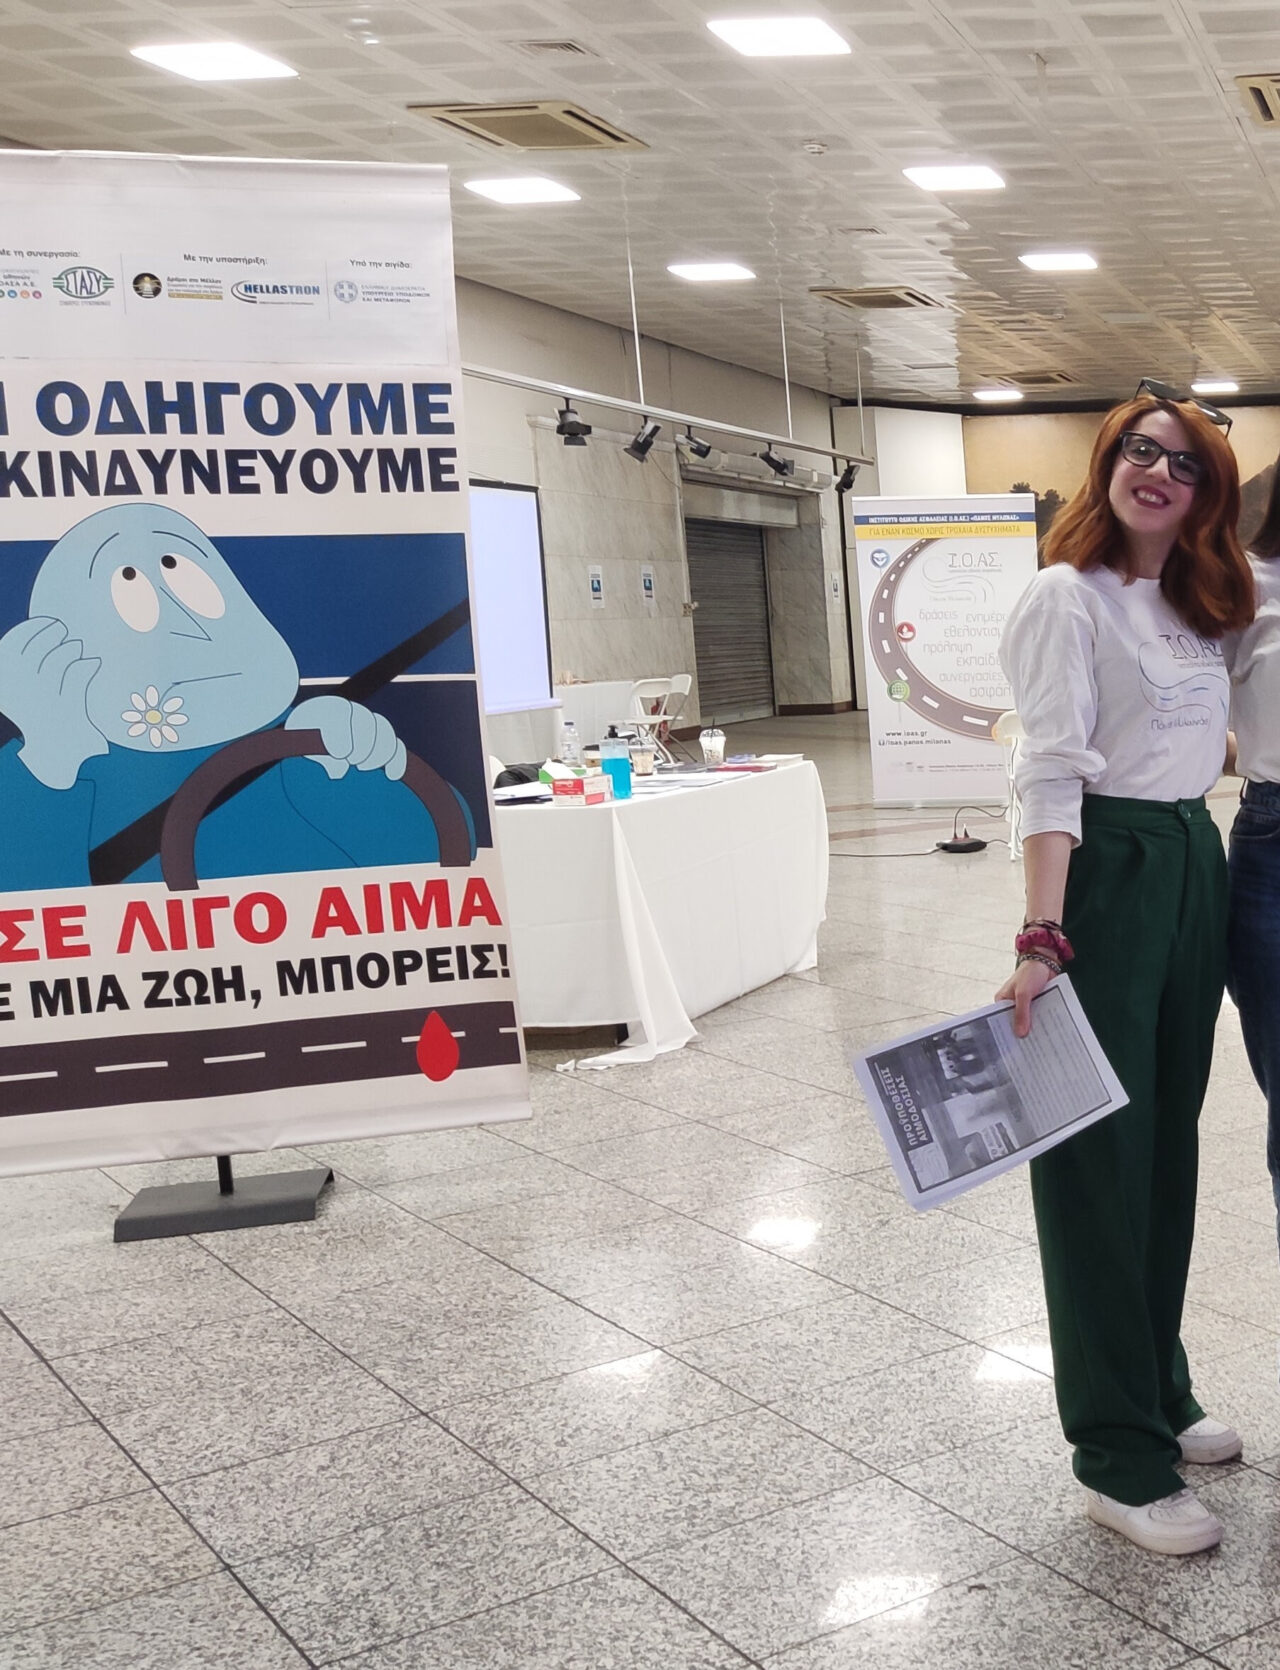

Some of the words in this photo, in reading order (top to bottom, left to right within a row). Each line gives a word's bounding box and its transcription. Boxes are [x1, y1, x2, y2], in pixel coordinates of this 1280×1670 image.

[184, 254, 196, 262] Με
[199, 256, 213, 264] την
[216, 255, 267, 266] υποστήριξη:
[350, 259, 366, 267] Υπό
[369, 261, 383, 269] την
[243, 283, 320, 296] HELLASTRON
[35, 380, 456, 437] ΟΔΗΓΟΥΜΕ
[0, 447, 460, 498] ΚΙΝΔΥΝΕΥΟΥΜΕ
[116, 891, 288, 954] ΛΙΓΟ
[311, 877, 503, 939] ΑΙΜΑ
[29, 974, 131, 1019] ΜΙΑ
[142, 965, 262, 1010] ΖΩΗ,
[276, 943, 512, 996] ΜΠΟΡΕΙΣ!
